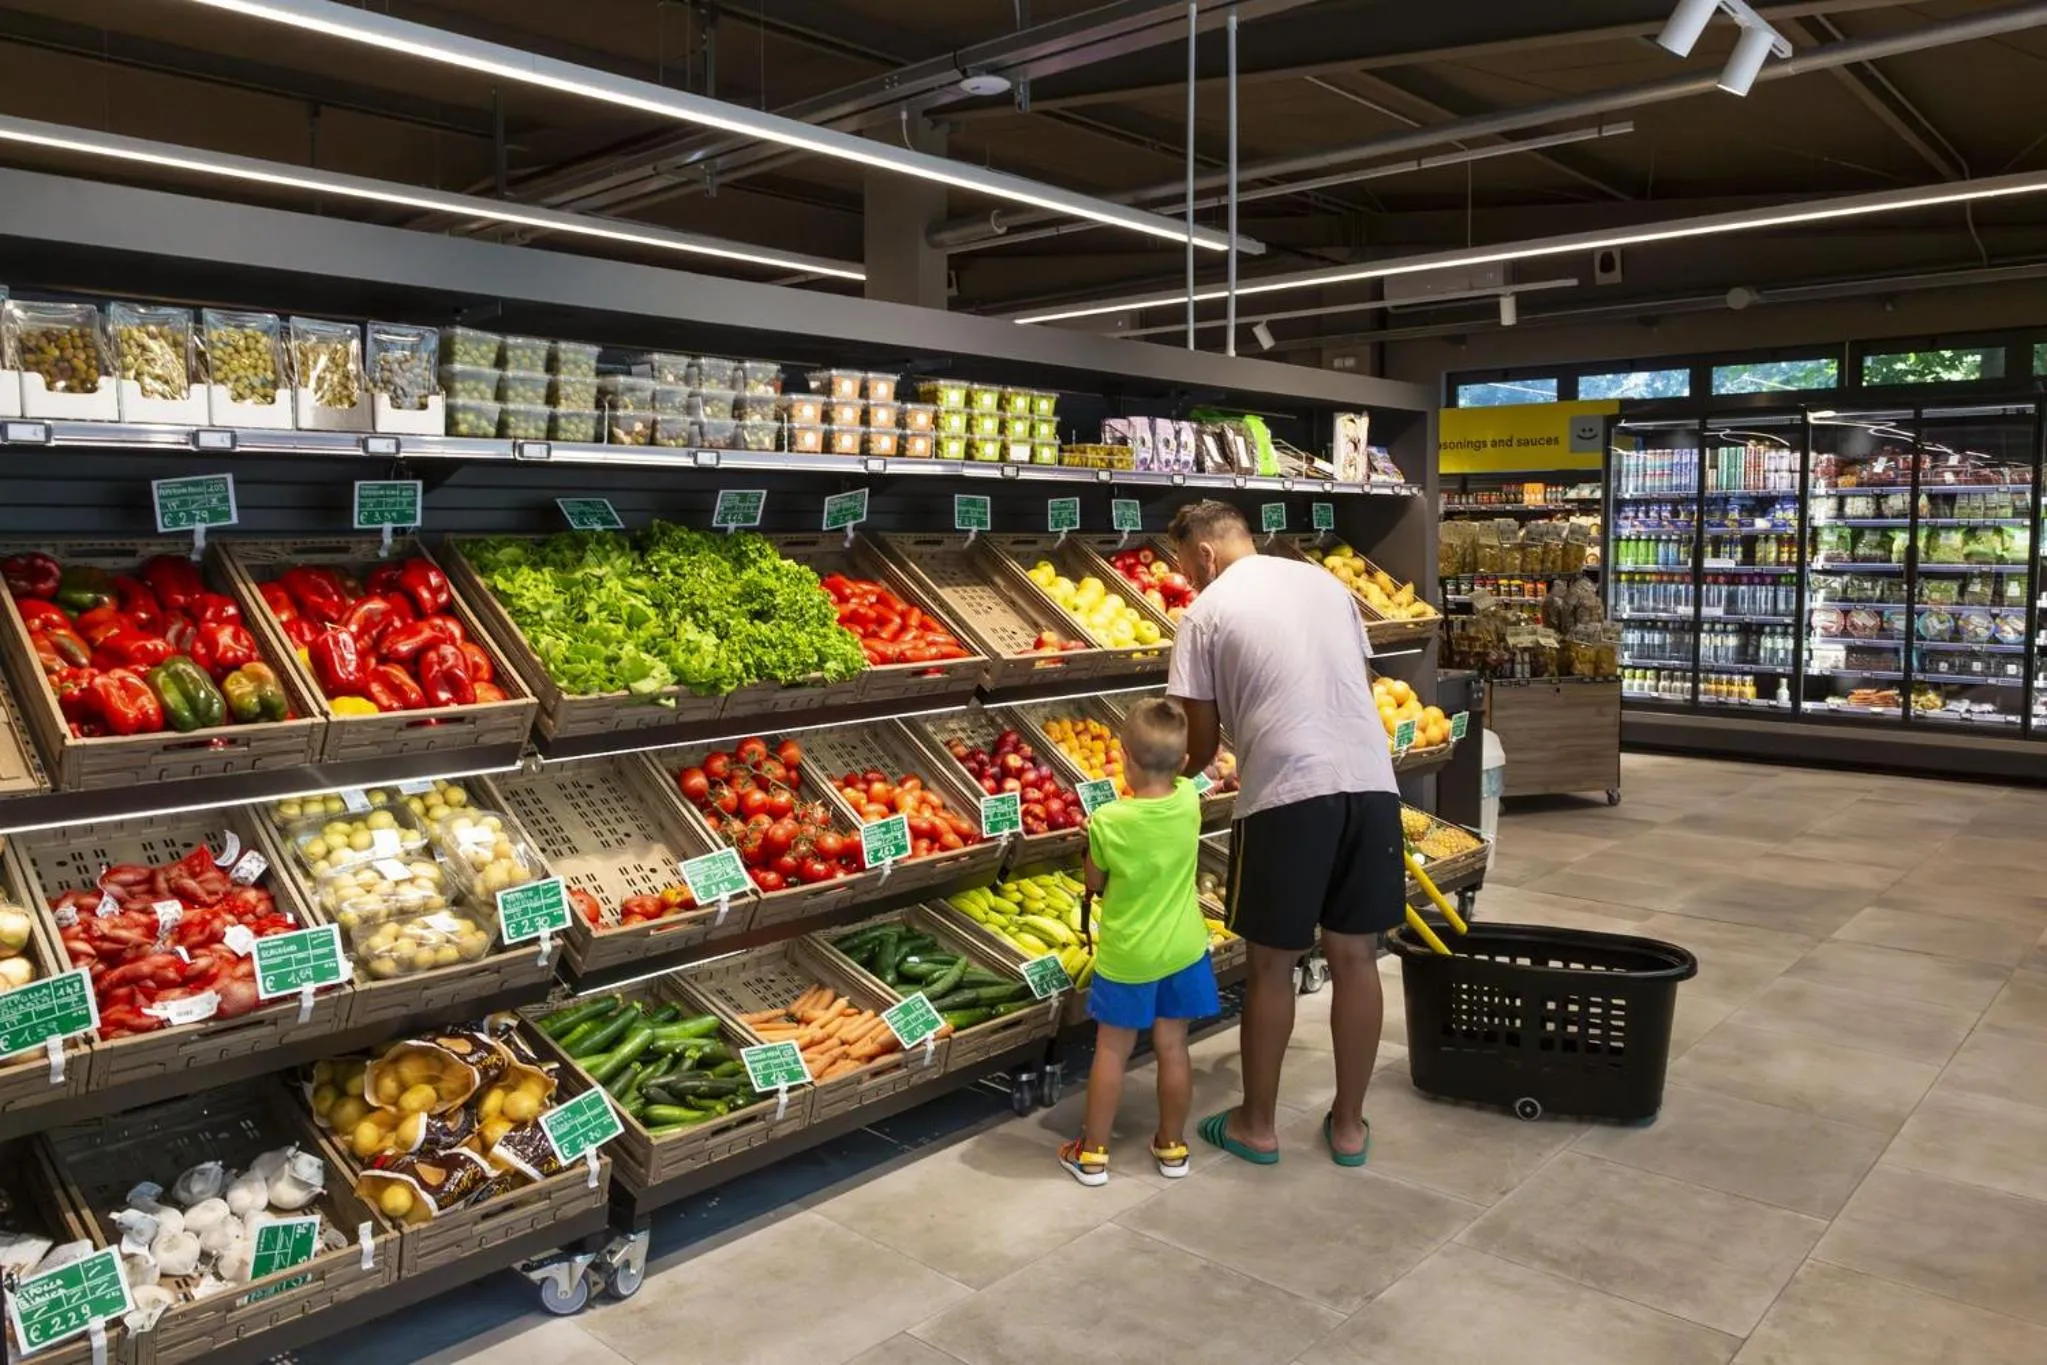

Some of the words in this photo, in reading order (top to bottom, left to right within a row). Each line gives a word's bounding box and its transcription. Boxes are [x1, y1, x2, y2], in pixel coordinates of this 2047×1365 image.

[1490, 436, 1513, 448] and
[1516, 436, 1560, 448] sauces
[508, 924, 517, 938] €
[265, 975, 276, 992] €
[0, 1034, 12, 1052] €
[562, 1143, 574, 1157] €
[29, 1323, 44, 1343] €
